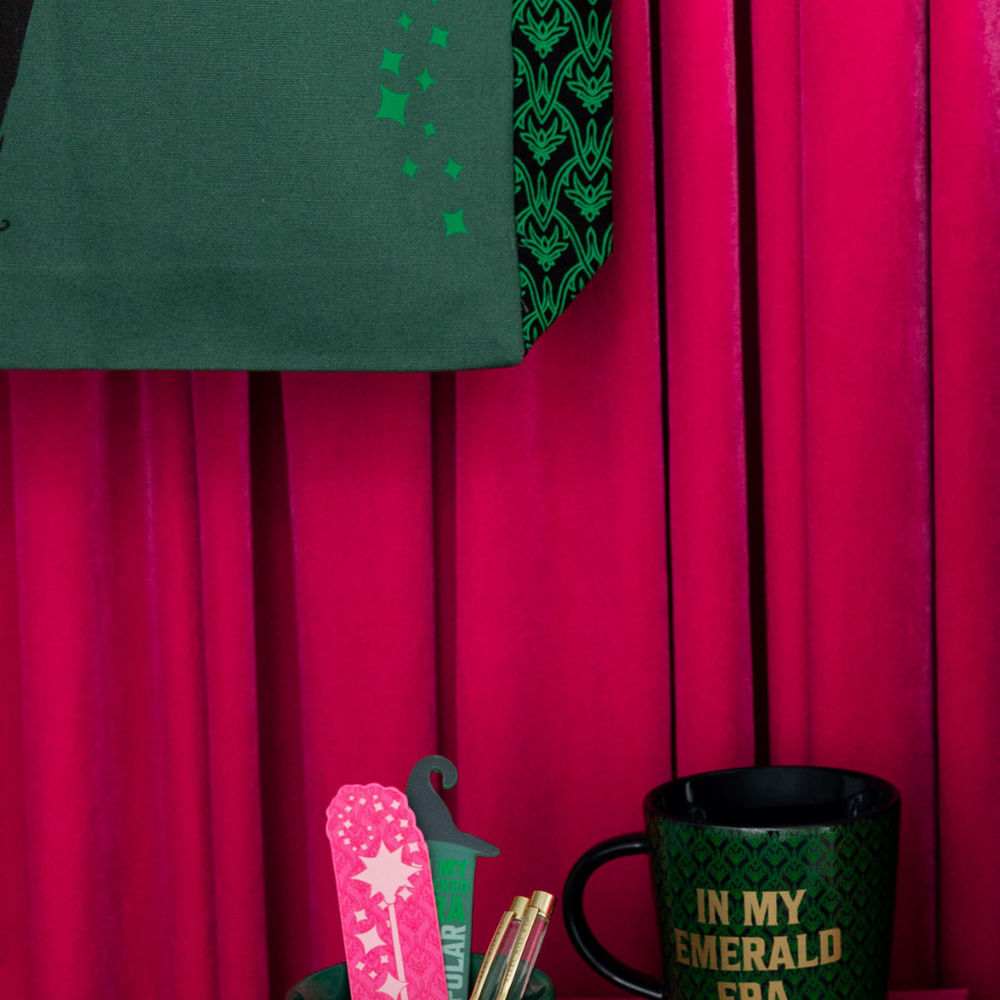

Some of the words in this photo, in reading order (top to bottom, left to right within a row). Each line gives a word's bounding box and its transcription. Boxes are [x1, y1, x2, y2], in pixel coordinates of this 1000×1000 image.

[696, 888, 730, 925] IN
[742, 889, 807, 926] MY
[674, 927, 842, 971] EMERALD
